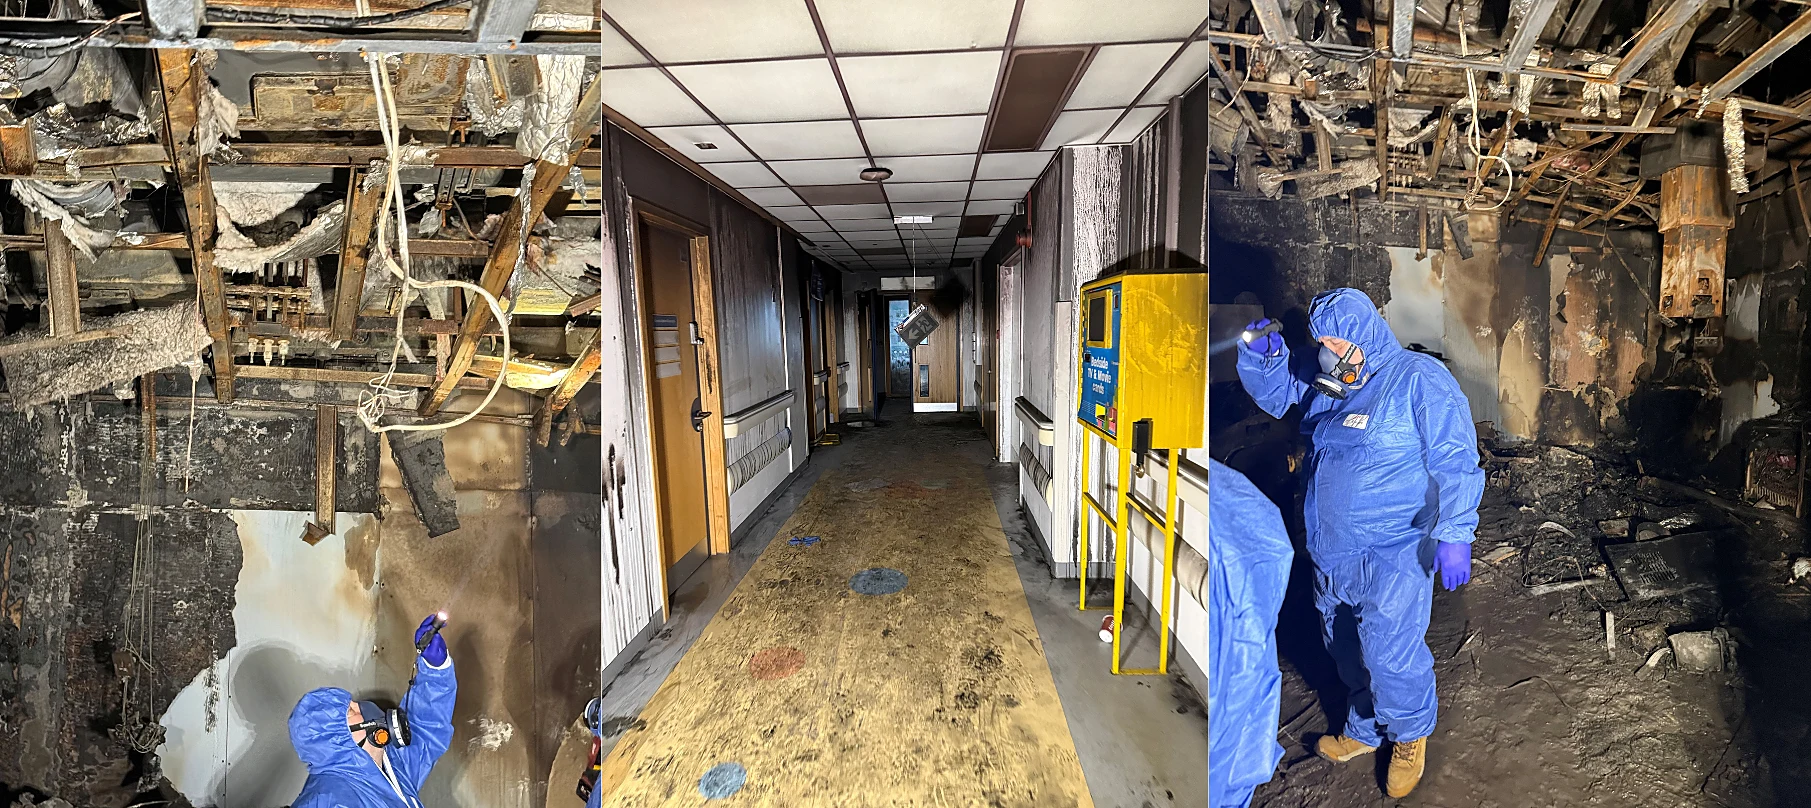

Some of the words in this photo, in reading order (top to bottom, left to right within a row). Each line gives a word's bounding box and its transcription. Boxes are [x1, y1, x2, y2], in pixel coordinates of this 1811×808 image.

[1091, 356, 1109, 369] Bedside
[1087, 367, 1093, 378] TV
[1093, 369, 1097, 379] &
[1098, 370, 1111, 383] Movie
[1092, 383, 1105, 395] cards
